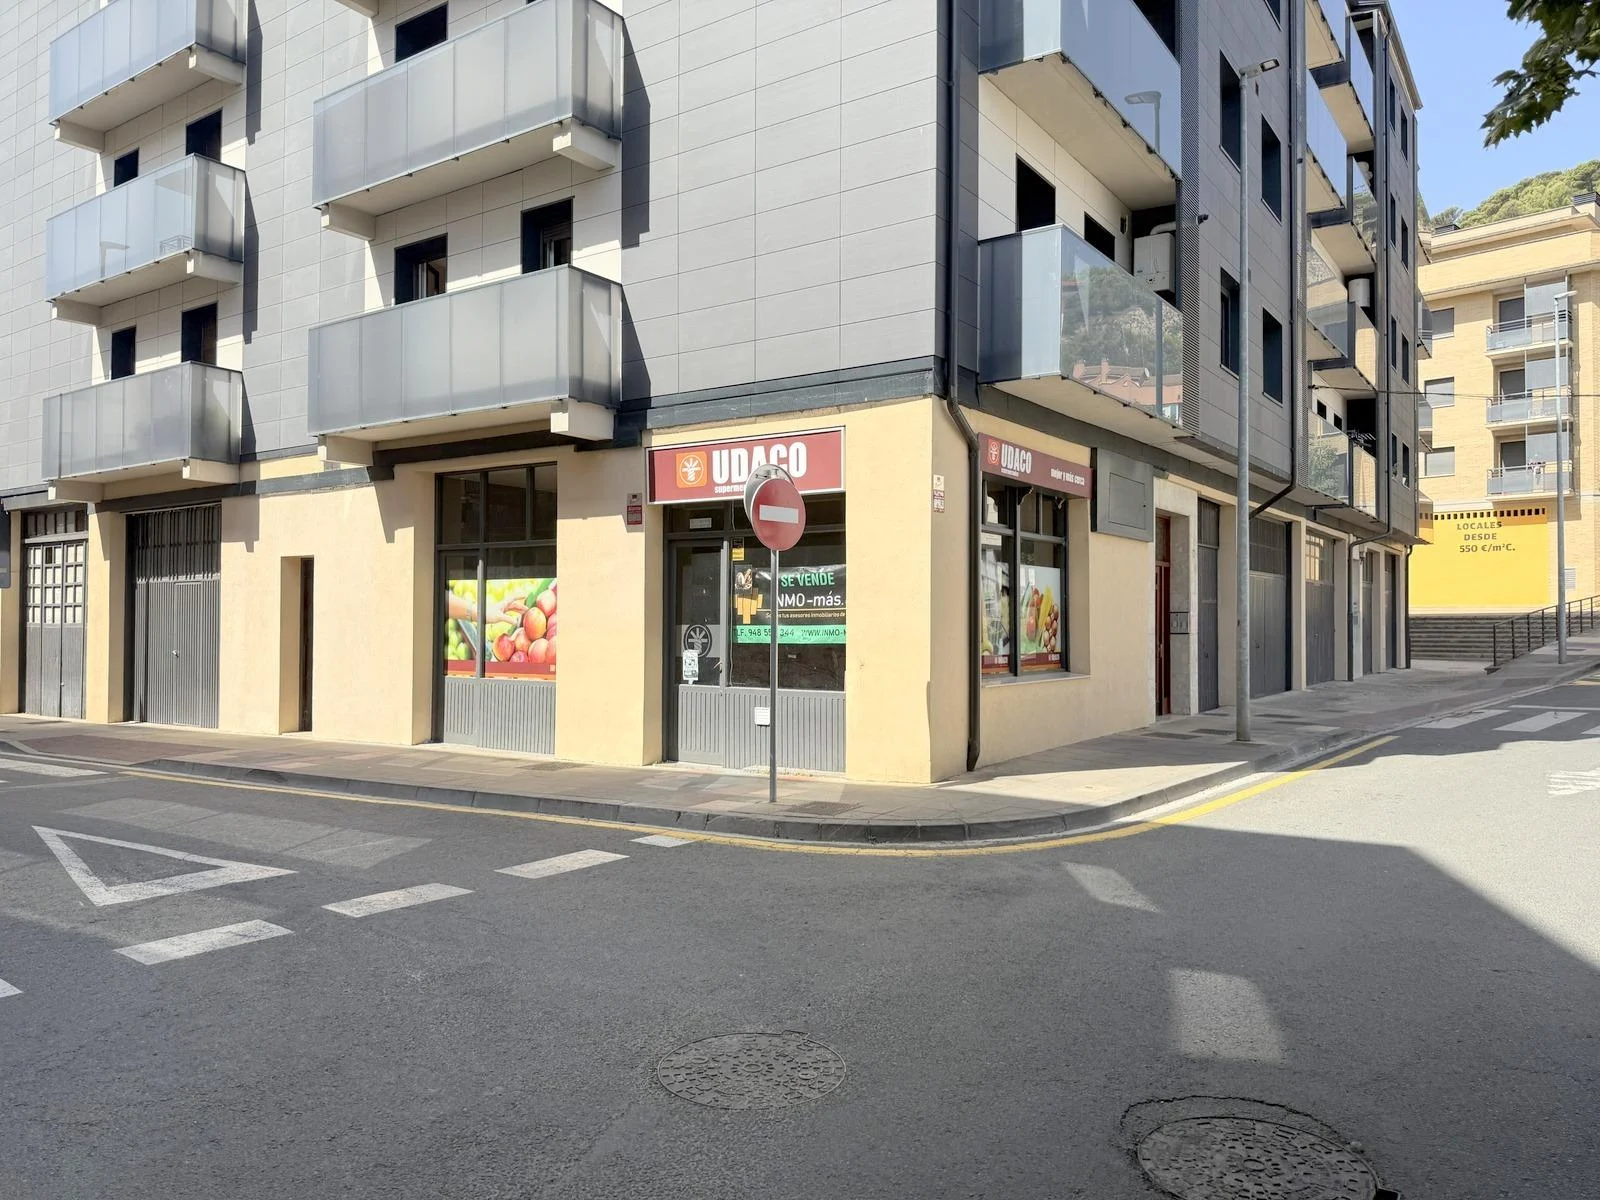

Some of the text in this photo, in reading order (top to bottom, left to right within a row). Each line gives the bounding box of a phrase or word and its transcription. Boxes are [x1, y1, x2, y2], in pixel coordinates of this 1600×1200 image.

[712, 442, 807, 484] UDACO
[1001, 443, 1032, 474] UDACO
[1456, 521, 1502, 530] LOCALES
[1464, 533, 1497, 541] DESDE
[1459, 545, 1478, 553] 550
[781, 572, 835, 587] SE VENDE
[777, 590, 844, 607] NMO-más.
[748, 628, 762, 637] 948
